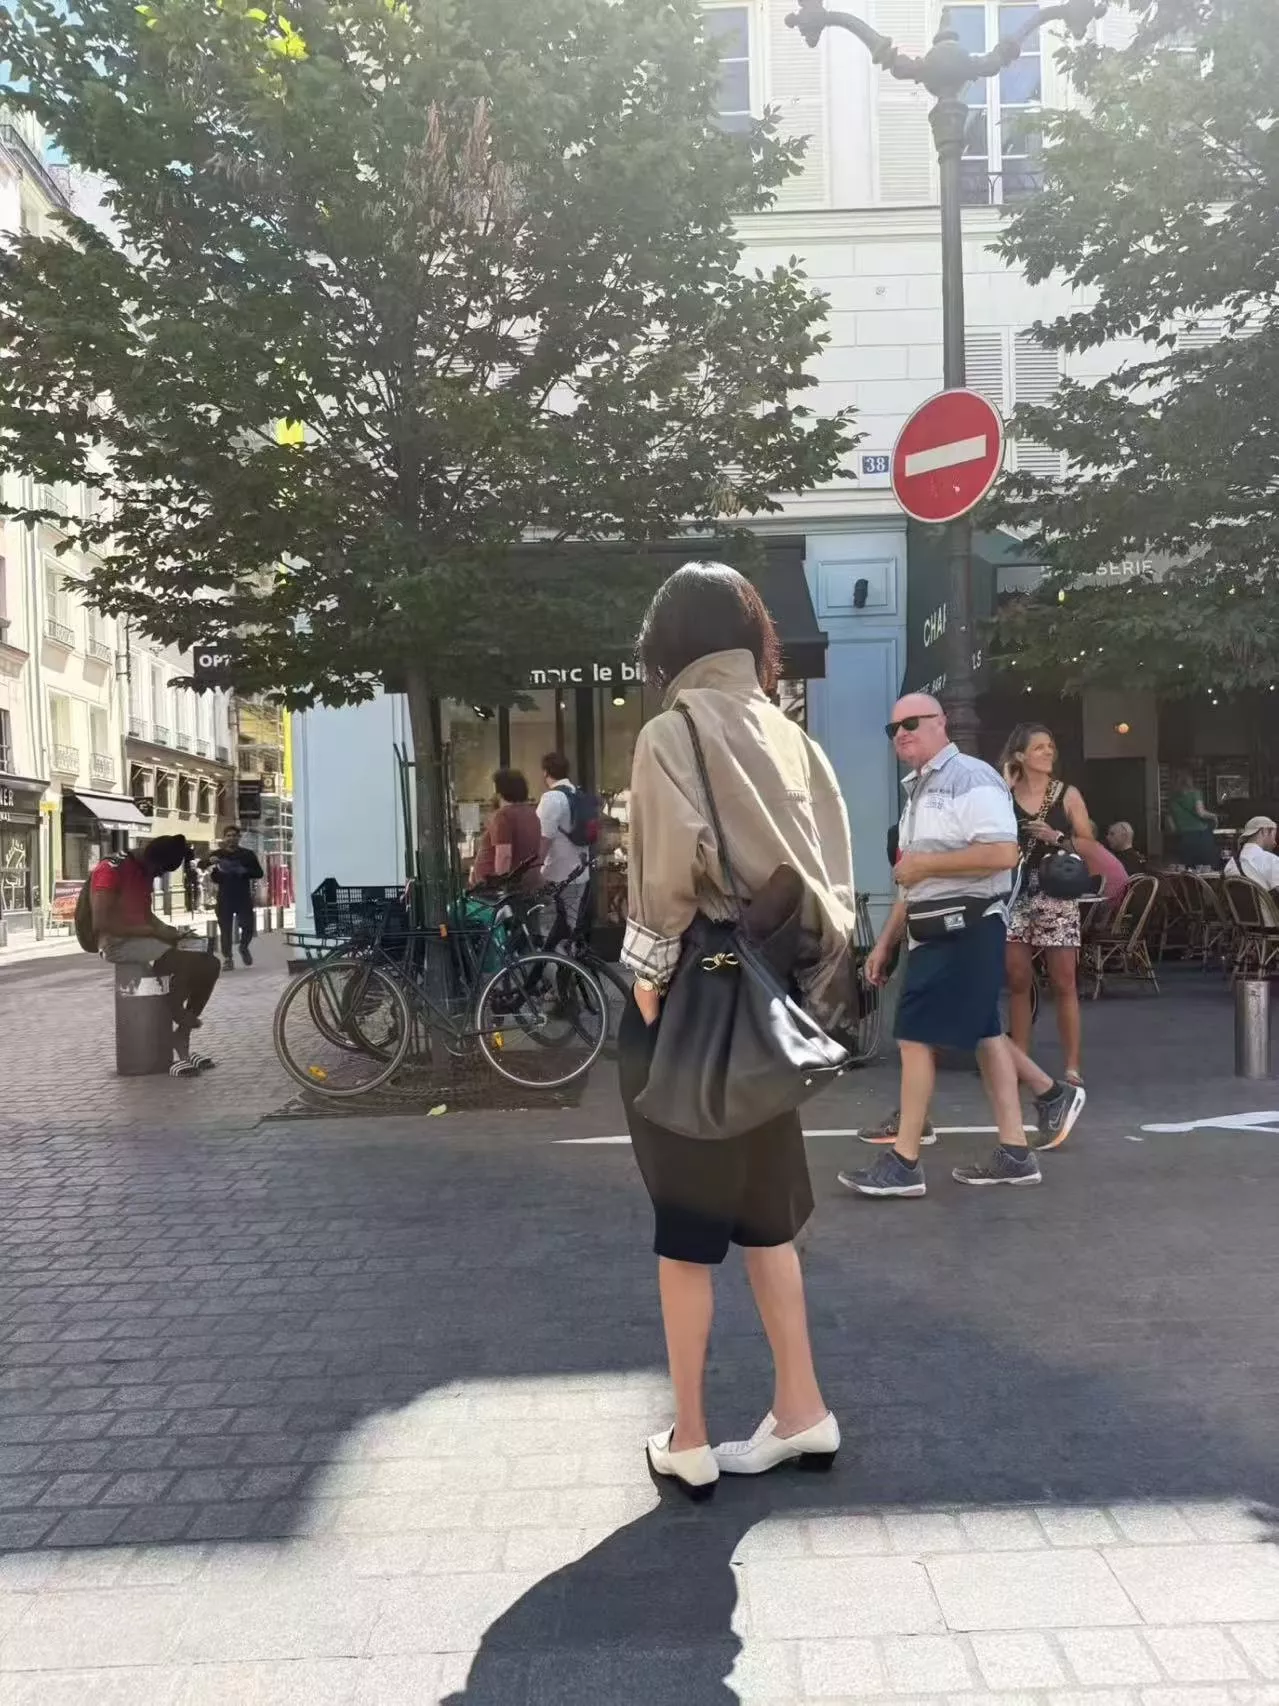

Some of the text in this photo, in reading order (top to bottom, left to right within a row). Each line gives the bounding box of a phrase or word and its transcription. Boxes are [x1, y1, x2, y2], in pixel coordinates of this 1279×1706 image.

[867, 457, 885, 472] 38
[593, 663, 613, 681] le
[621, 661, 645, 682] bi
